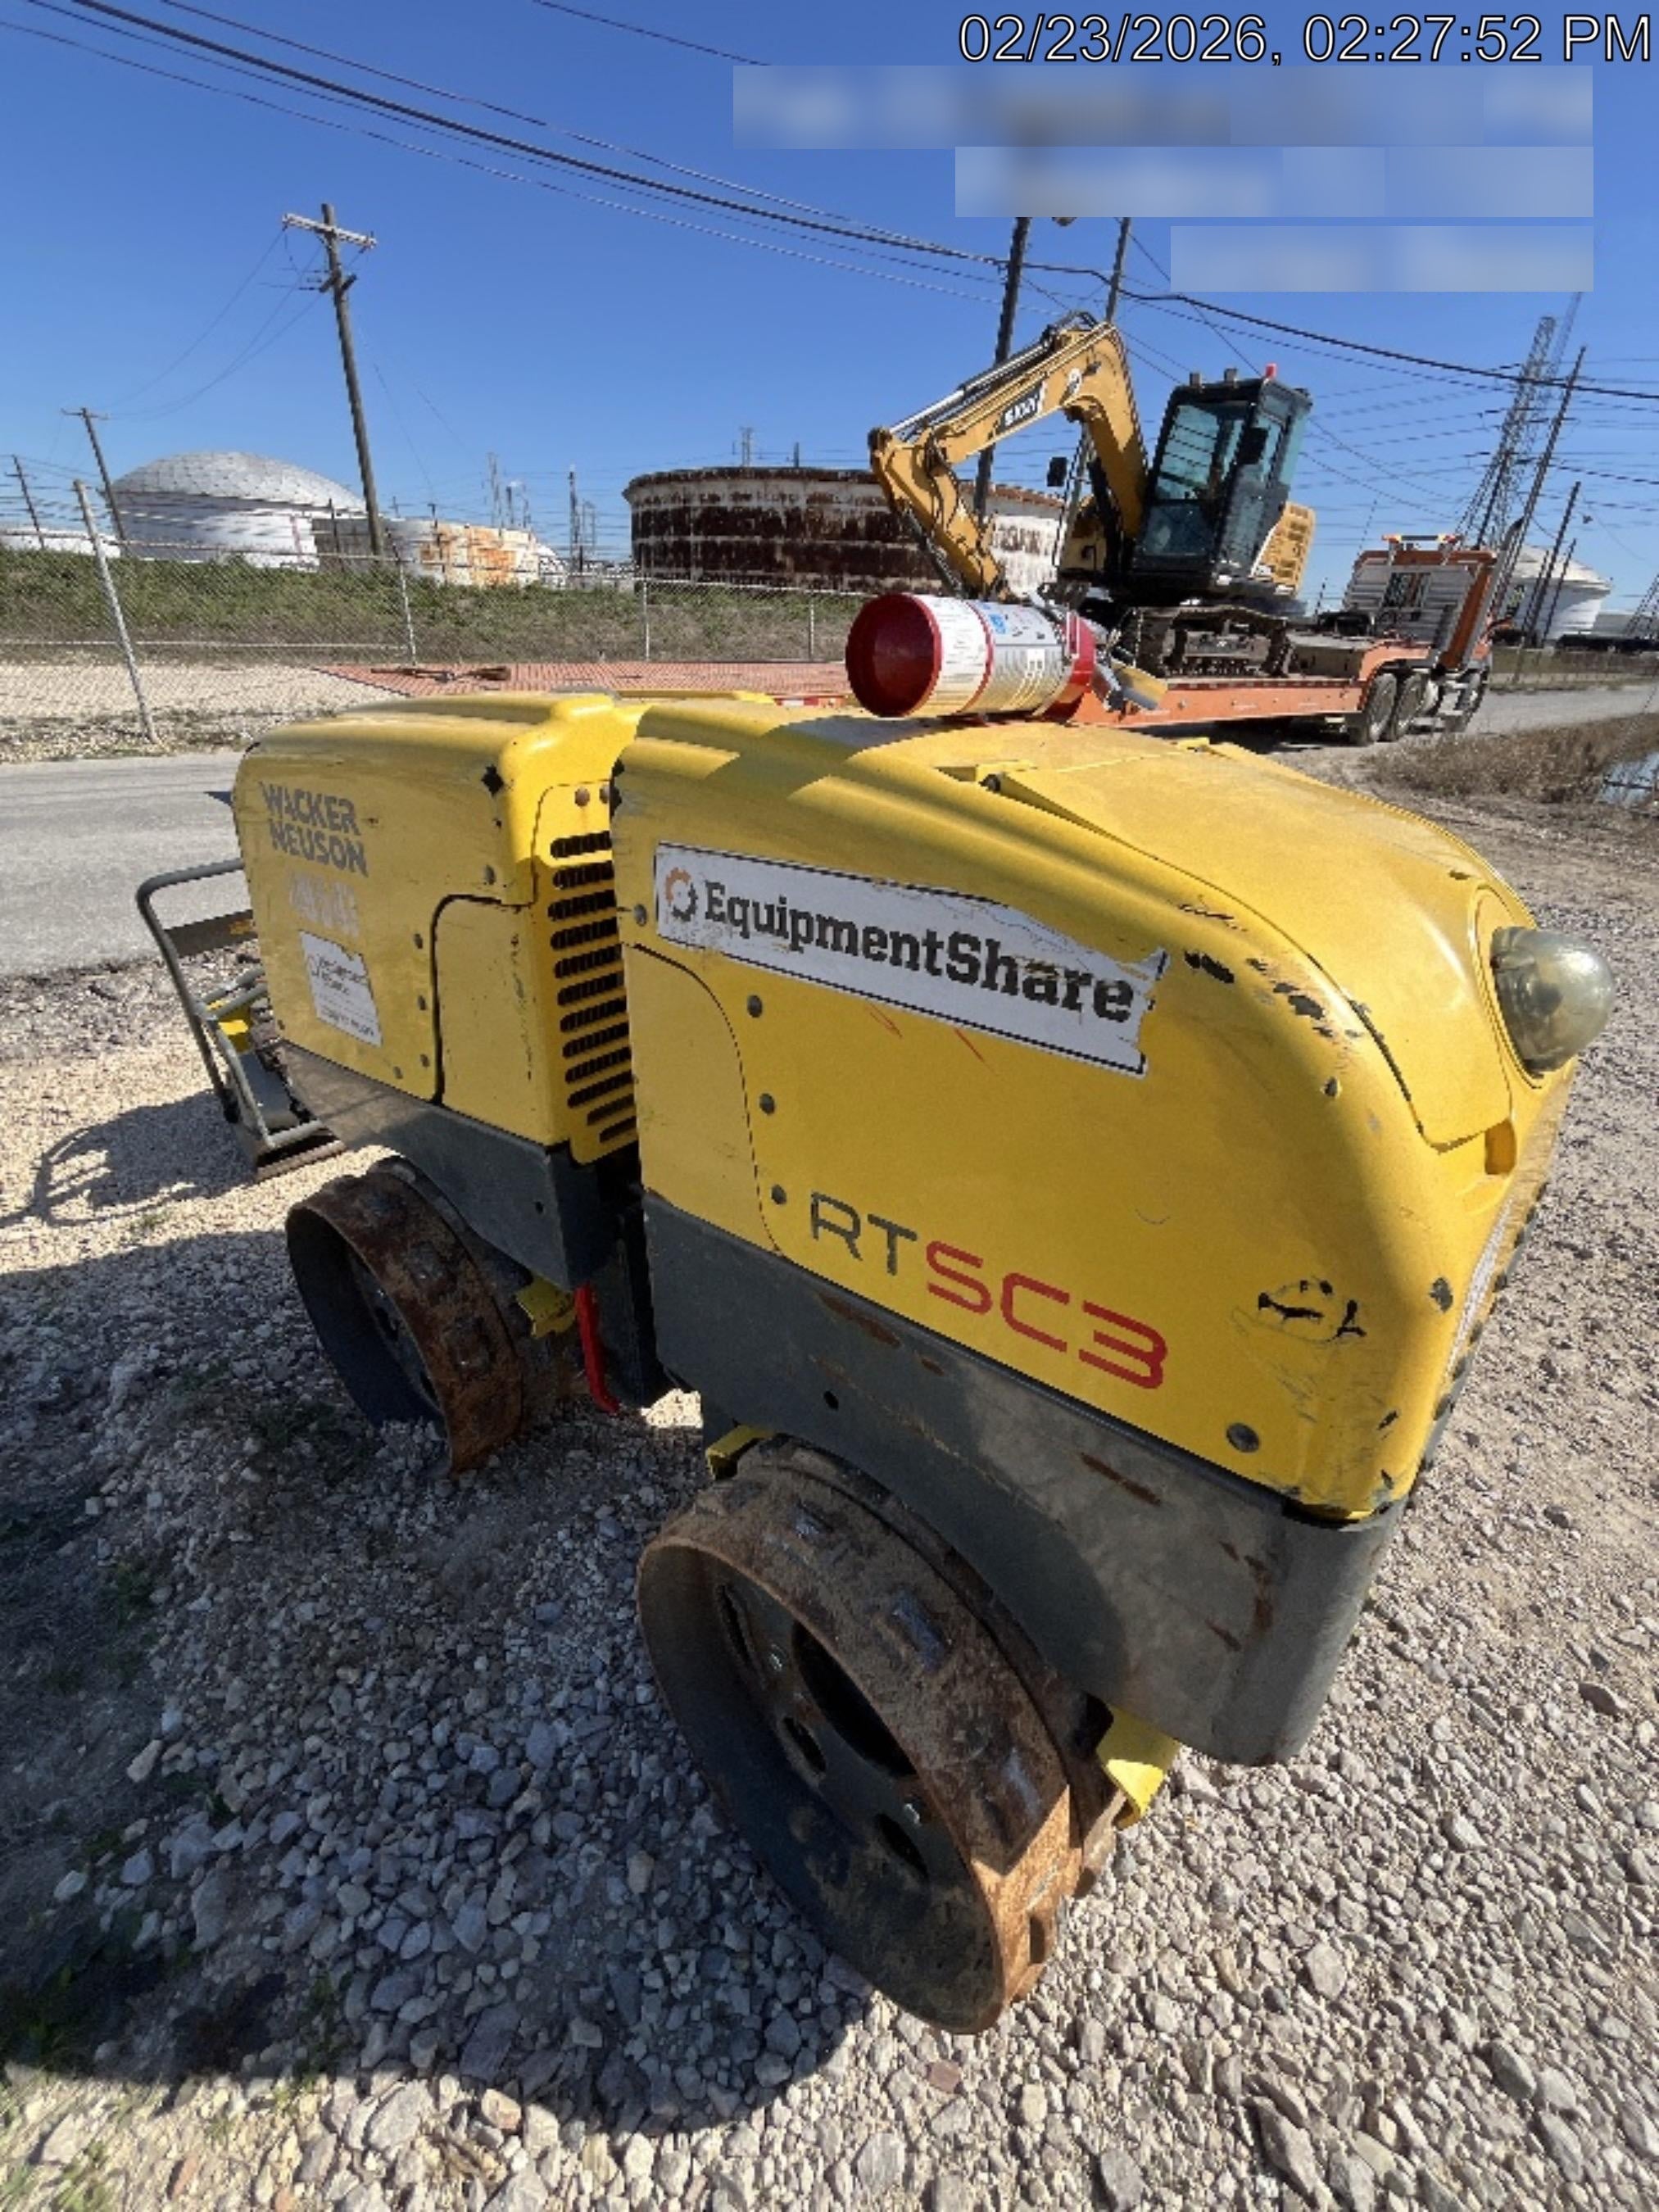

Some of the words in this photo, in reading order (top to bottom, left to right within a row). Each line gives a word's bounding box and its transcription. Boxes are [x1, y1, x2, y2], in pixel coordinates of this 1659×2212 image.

[258, 781, 360, 836] WACKER
[268, 818, 368, 877] NEUSON
[705, 879, 1135, 1023] EquipmentShare
